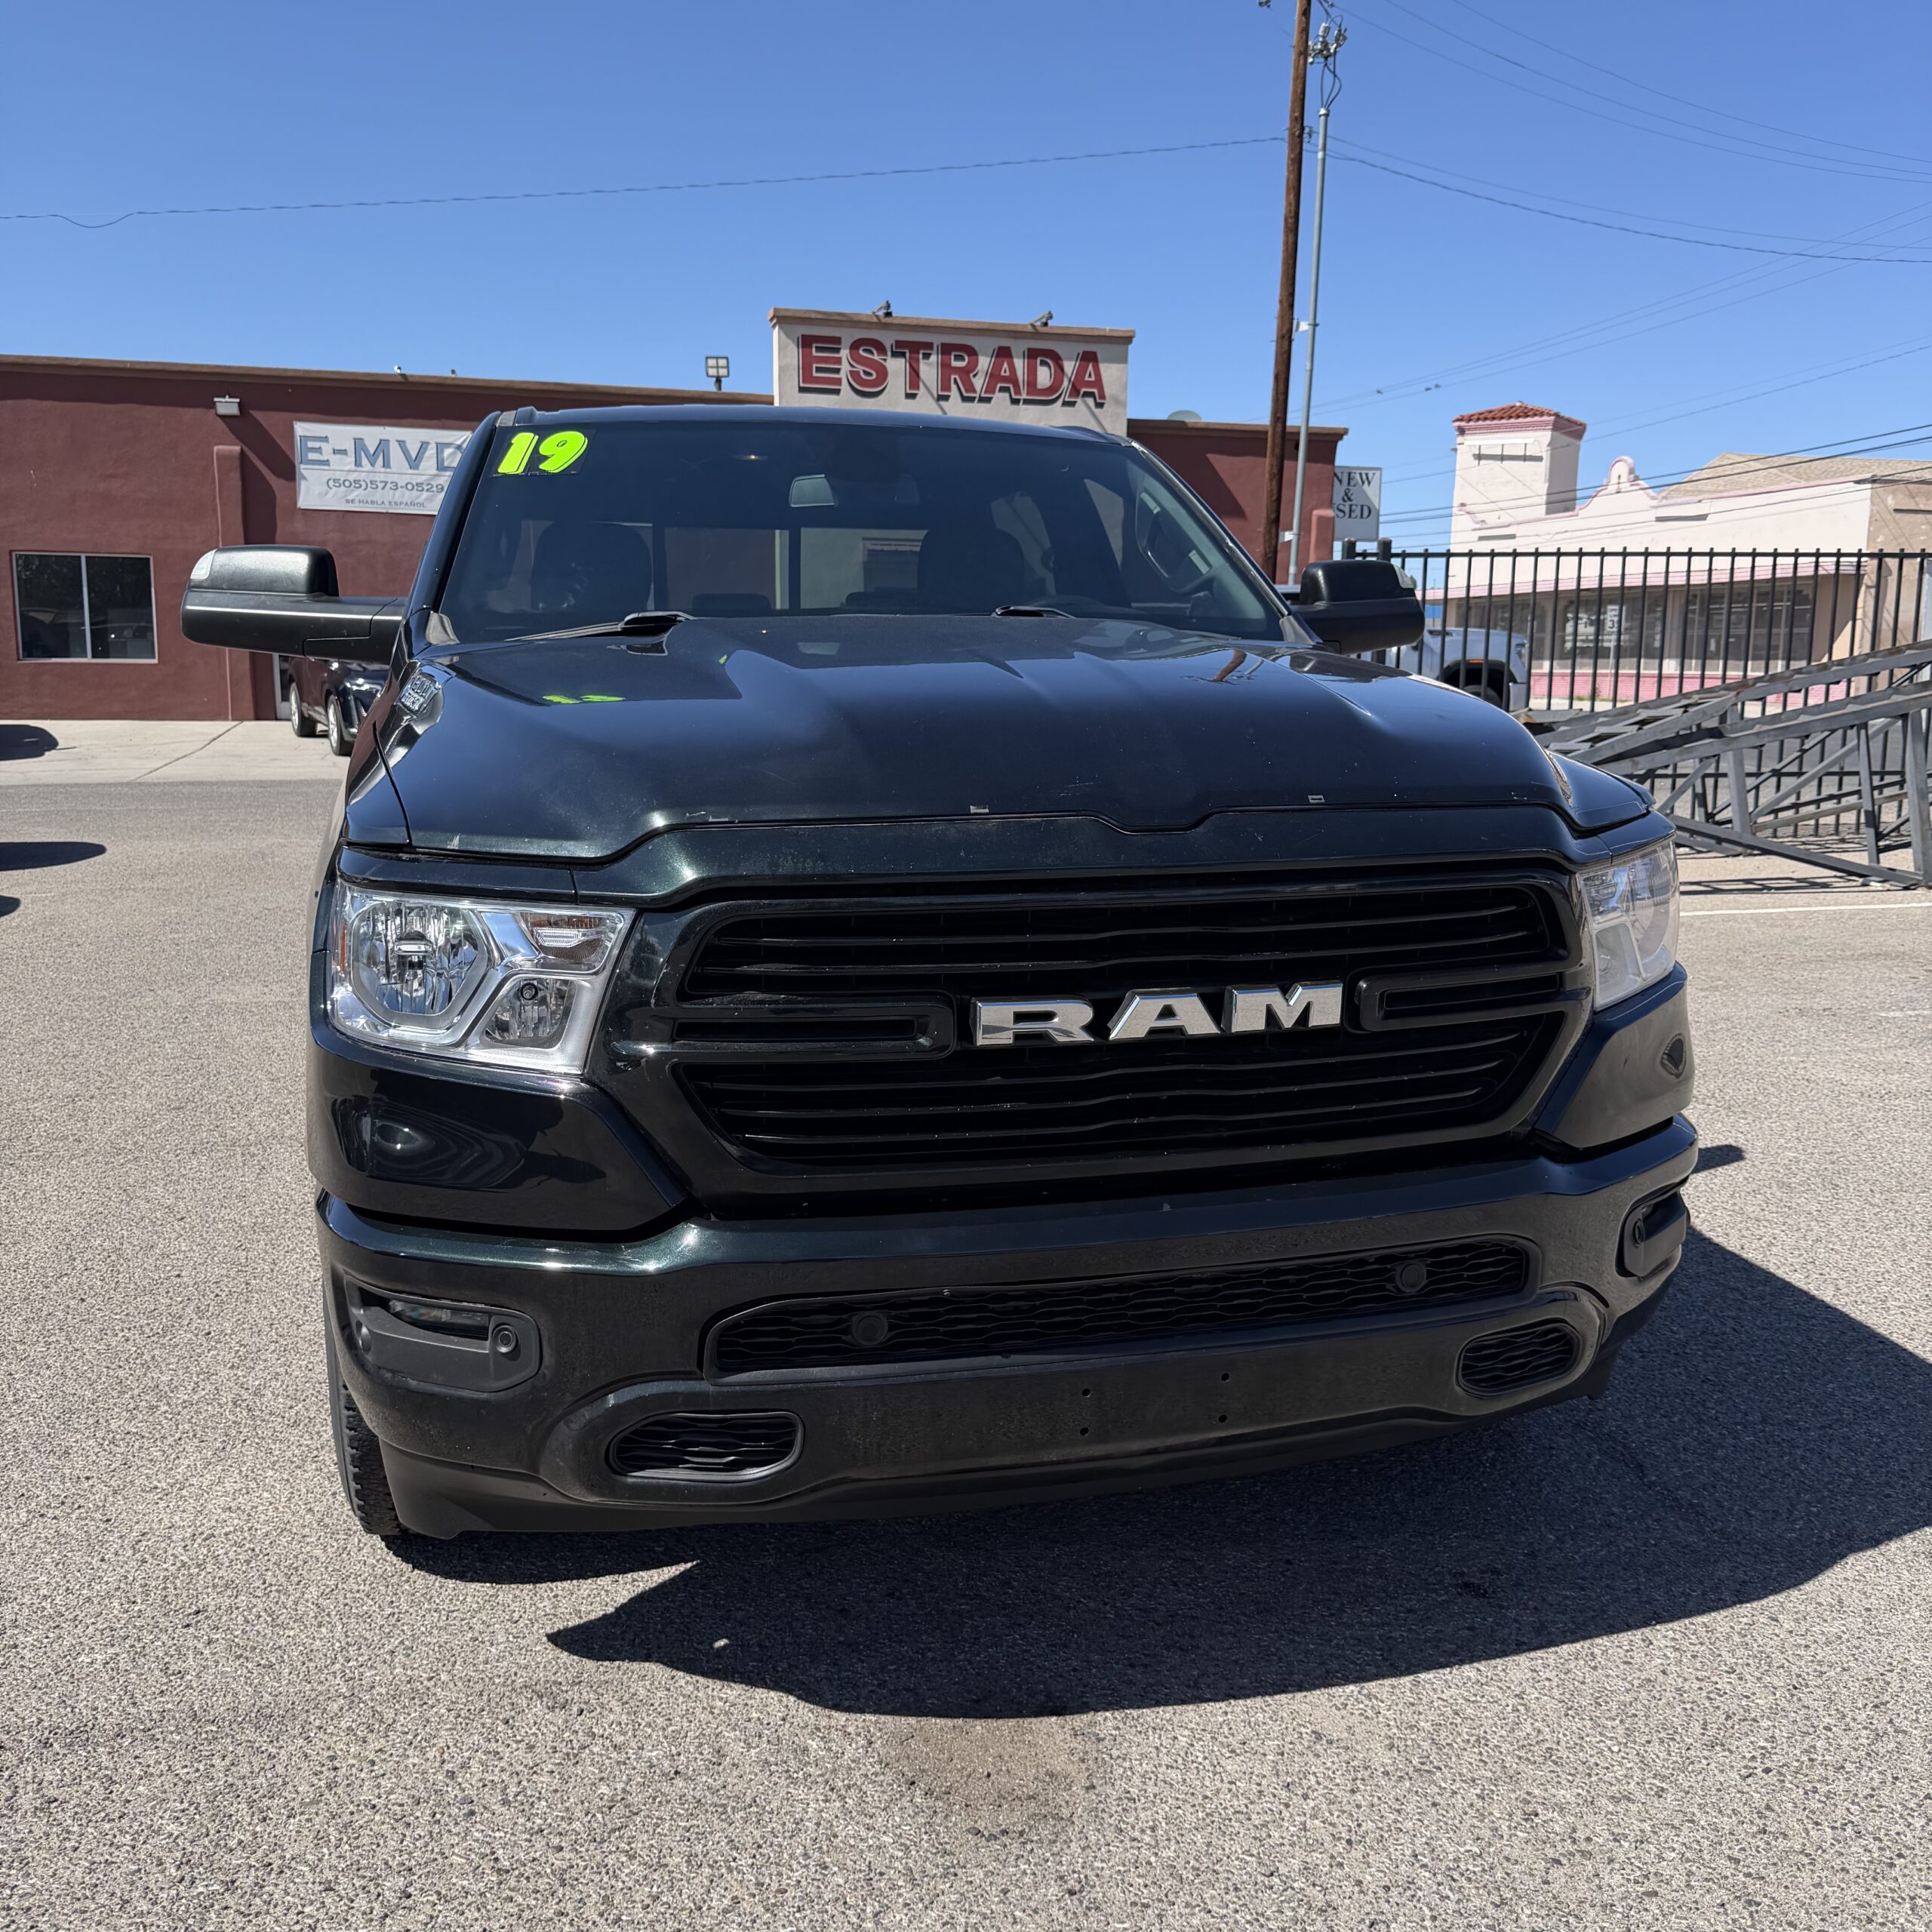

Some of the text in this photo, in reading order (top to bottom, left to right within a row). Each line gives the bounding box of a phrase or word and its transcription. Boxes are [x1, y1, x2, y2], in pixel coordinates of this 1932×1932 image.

[798, 334, 1106, 408] ESTRADA
[299, 435, 463, 472] E-MVD
[497, 431, 588, 475] 19
[326, 477, 445, 494] (505)573-0529
[1334, 471, 1376, 487] NEW
[1341, 488, 1353, 503] &
[388, 500, 427, 509] ESPAÑOL
[1333, 503, 1371, 520] SED
[971, 981, 1343, 1047] RAM
